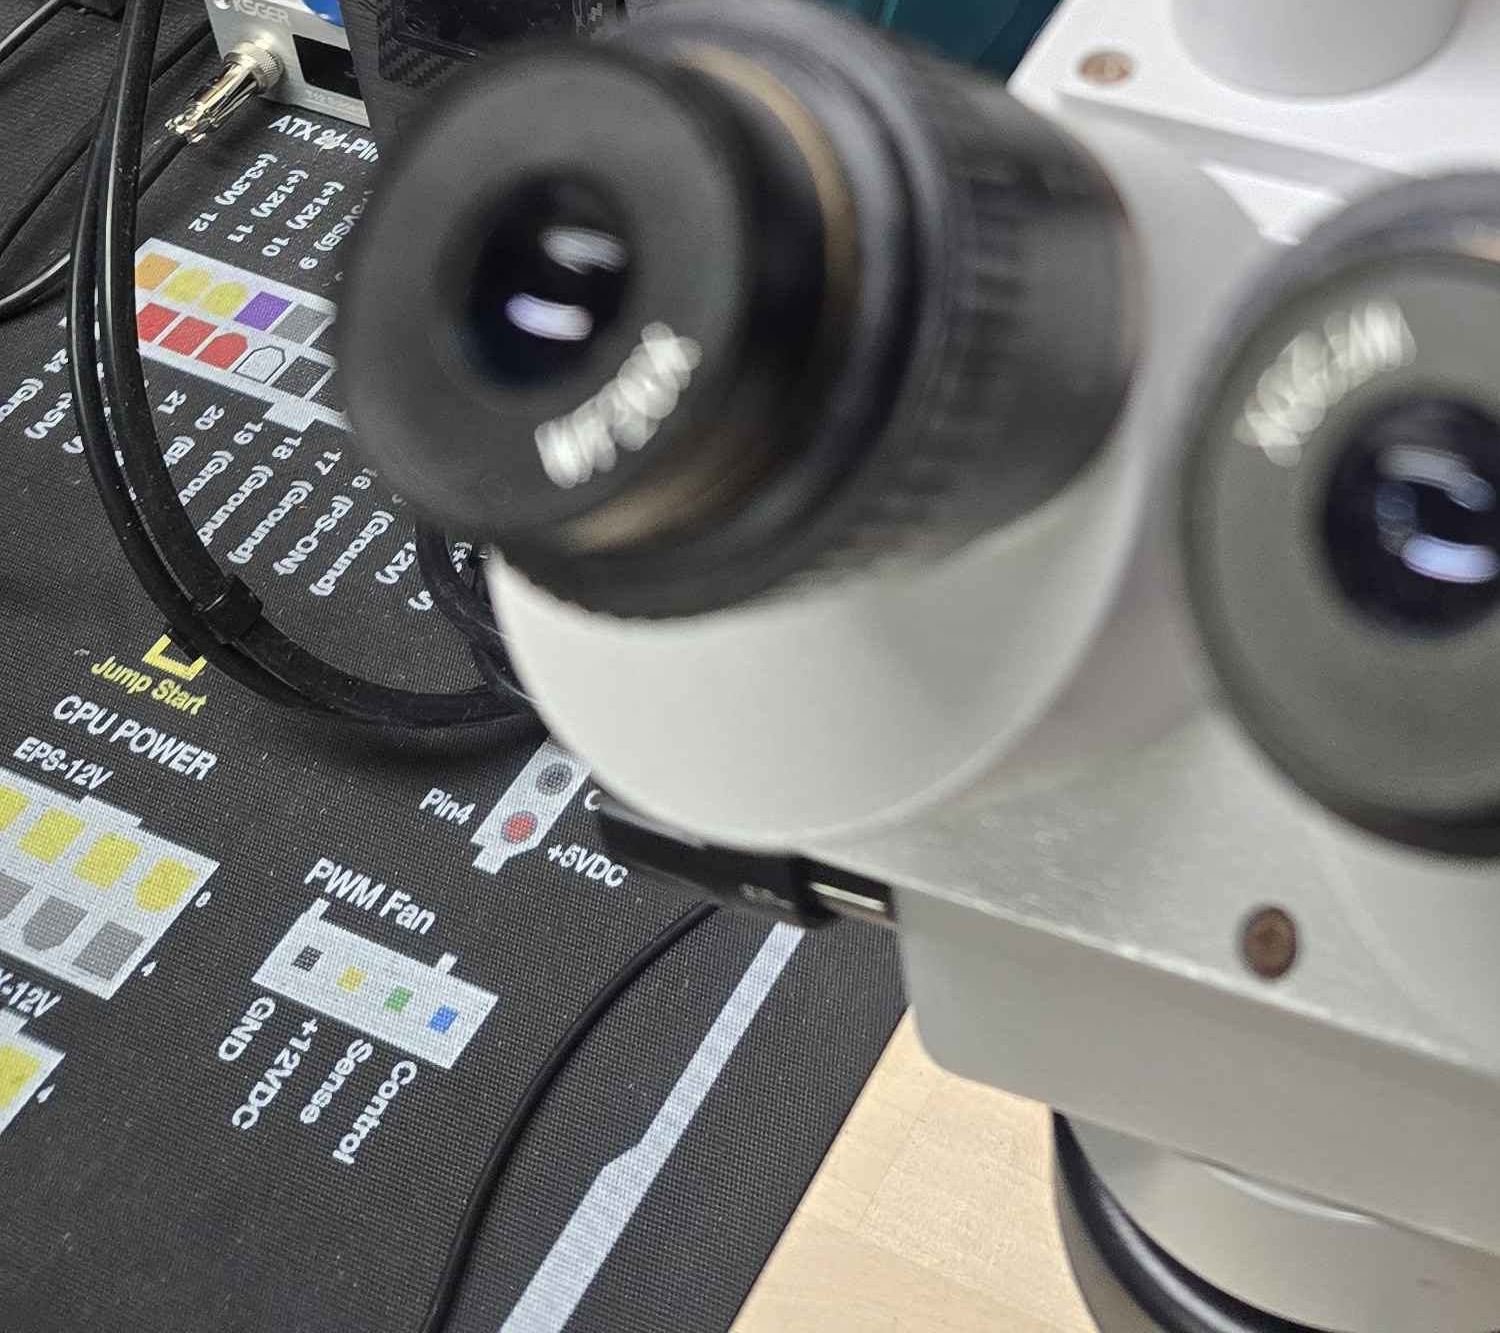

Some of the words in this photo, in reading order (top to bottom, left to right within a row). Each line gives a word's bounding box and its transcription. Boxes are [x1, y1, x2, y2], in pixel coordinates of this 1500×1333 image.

[268, 115, 321, 141] ATX
[250, 169, 309, 218] (+12V)
[286, 181, 345, 230] (+12V)
[188, 212, 219, 232] 12
[227, 224, 255, 243] 11
[262, 237, 290, 257] 10
[194, 404, 225, 430] 20
[233, 421, 264, 445] 19
[272, 436, 303, 460] 18
[315, 449, 343, 476] 17
[227, 480, 314, 564] (Ground)
[273, 494, 354, 576] (PS-ON)
[309, 510, 395, 597] (Ground)
[91, 656, 153, 694] Jump
[151, 678, 207, 715] Start
[13, 736, 114, 790] EPS-12V
[53, 695, 119, 735] CPU
[109, 719, 218, 780] POWER
[418, 787, 476, 825] Pin4
[304, 857, 386, 910] PWM
[379, 890, 437, 935] Fan
[218, 996, 276, 1061] GND
[232, 1019, 318, 1130] +12VDC
[300, 1039, 374, 1124] Sense
[332, 1060, 418, 1165] Control
